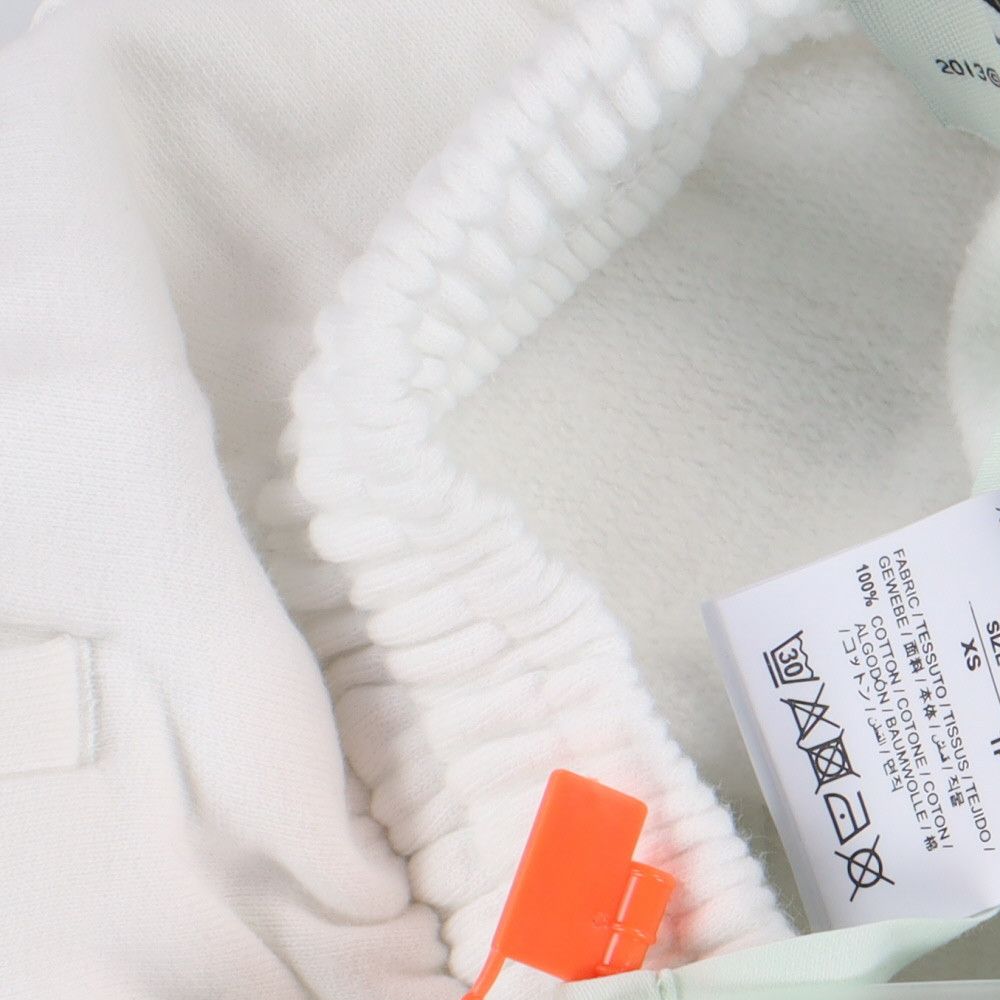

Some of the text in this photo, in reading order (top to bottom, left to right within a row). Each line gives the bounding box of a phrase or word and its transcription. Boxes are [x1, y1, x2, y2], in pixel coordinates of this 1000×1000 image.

[935, 58, 1000, 87] 2013©
[778, 648, 804, 678] 30
[842, 636, 870, 700] コットン
[878, 555, 909, 629] GEWEBE
[903, 640, 924, 673] 面料
[920, 687, 937, 720] 本体
[960, 637, 981, 672] XS
[854, 623, 890, 704] ALGODÓN
[885, 716, 928, 823] BAUMWOLLE
[856, 563, 879, 607] 100%
[871, 615, 901, 685] COTTON
[897, 697, 928, 769] COTONE
[923, 780, 950, 841] COTON
[893, 548, 920, 609] FABRIC
[916, 619, 947, 699] TESSUTO
[943, 710, 969, 772] TISSUS
[965, 782, 991, 843] TEJIDO
